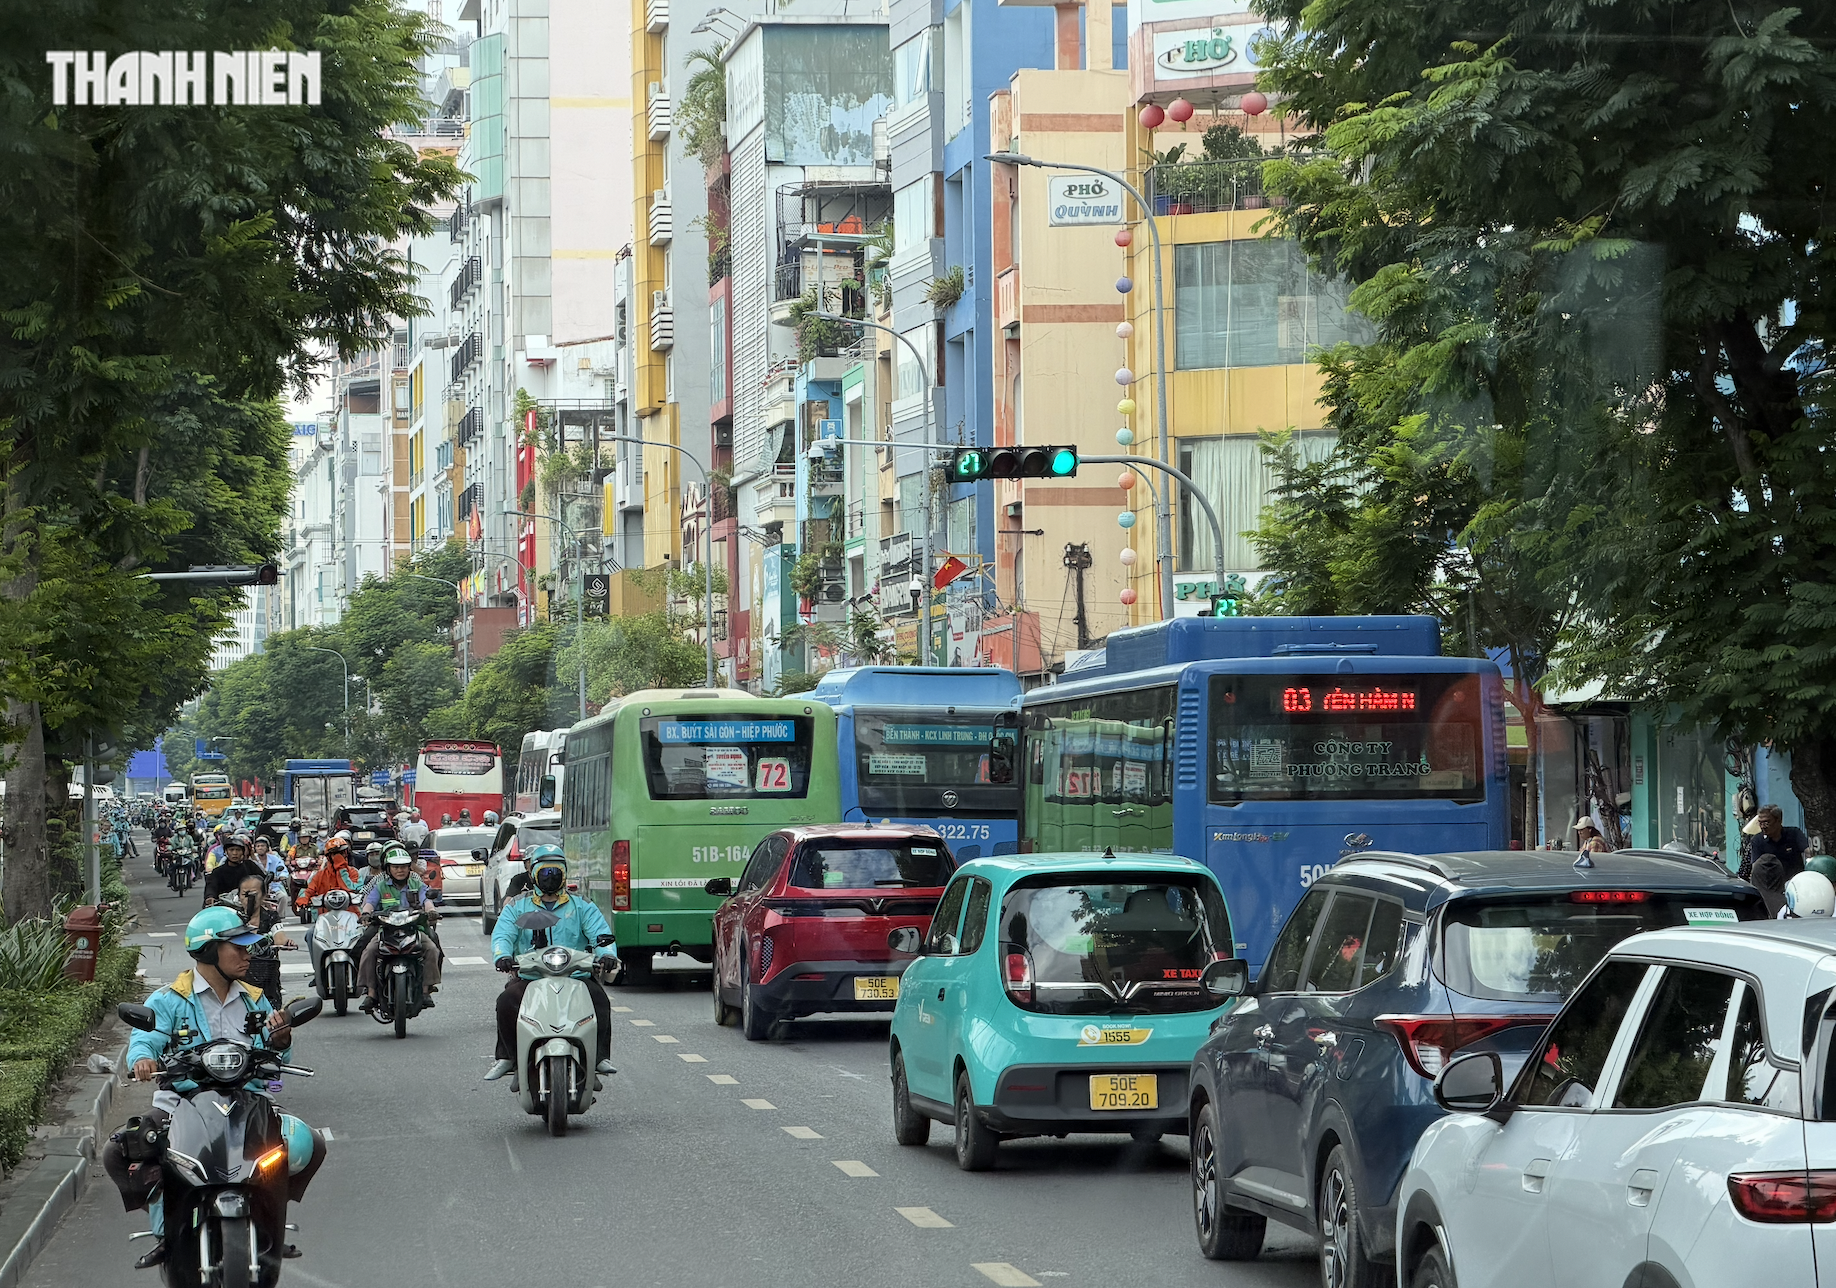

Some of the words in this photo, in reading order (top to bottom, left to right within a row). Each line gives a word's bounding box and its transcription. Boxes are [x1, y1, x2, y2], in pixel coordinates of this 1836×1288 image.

[1067, 178, 1104, 197] PHỞ
[1054, 201, 1118, 219] QUỲNH
[960, 453, 980, 474] 27
[1283, 687, 1312, 712] 03
[666, 725, 680, 740] BX.
[681, 723, 702, 739] BUÝT
[704, 723, 717, 739] SÀI
[719, 723, 735, 739] GÒN
[742, 722, 760, 740] HIỆP
[761, 722, 788, 738] PHƯỚC
[886, 726, 899, 740] BẾN
[900, 728, 920, 740] THÀNH
[925, 731, 938, 741] KCX
[939, 731, 952, 741] LINH
[953, 731, 974, 741] TRUNG
[1313, 739, 1363, 755] CÔNG
[1367, 741, 1392, 755] TY
[761, 763, 787, 787] 72
[1287, 762, 1362, 777] PHƯƠNG
[1367, 762, 1431, 777] TRANG
[938, 824, 990, 840] 322.75
[1699, 911, 1714, 919] HỢP
[1163, 969, 1178, 979] XE
[1180, 968, 1203, 978] TAXI
[868, 978, 887, 989] 50E
[861, 988, 895, 999] 730.53
[1104, 1031, 1131, 1042] 1555
[1109, 1077, 1137, 1092] 50E
[1099, 1093, 1149, 1107] 709.20
